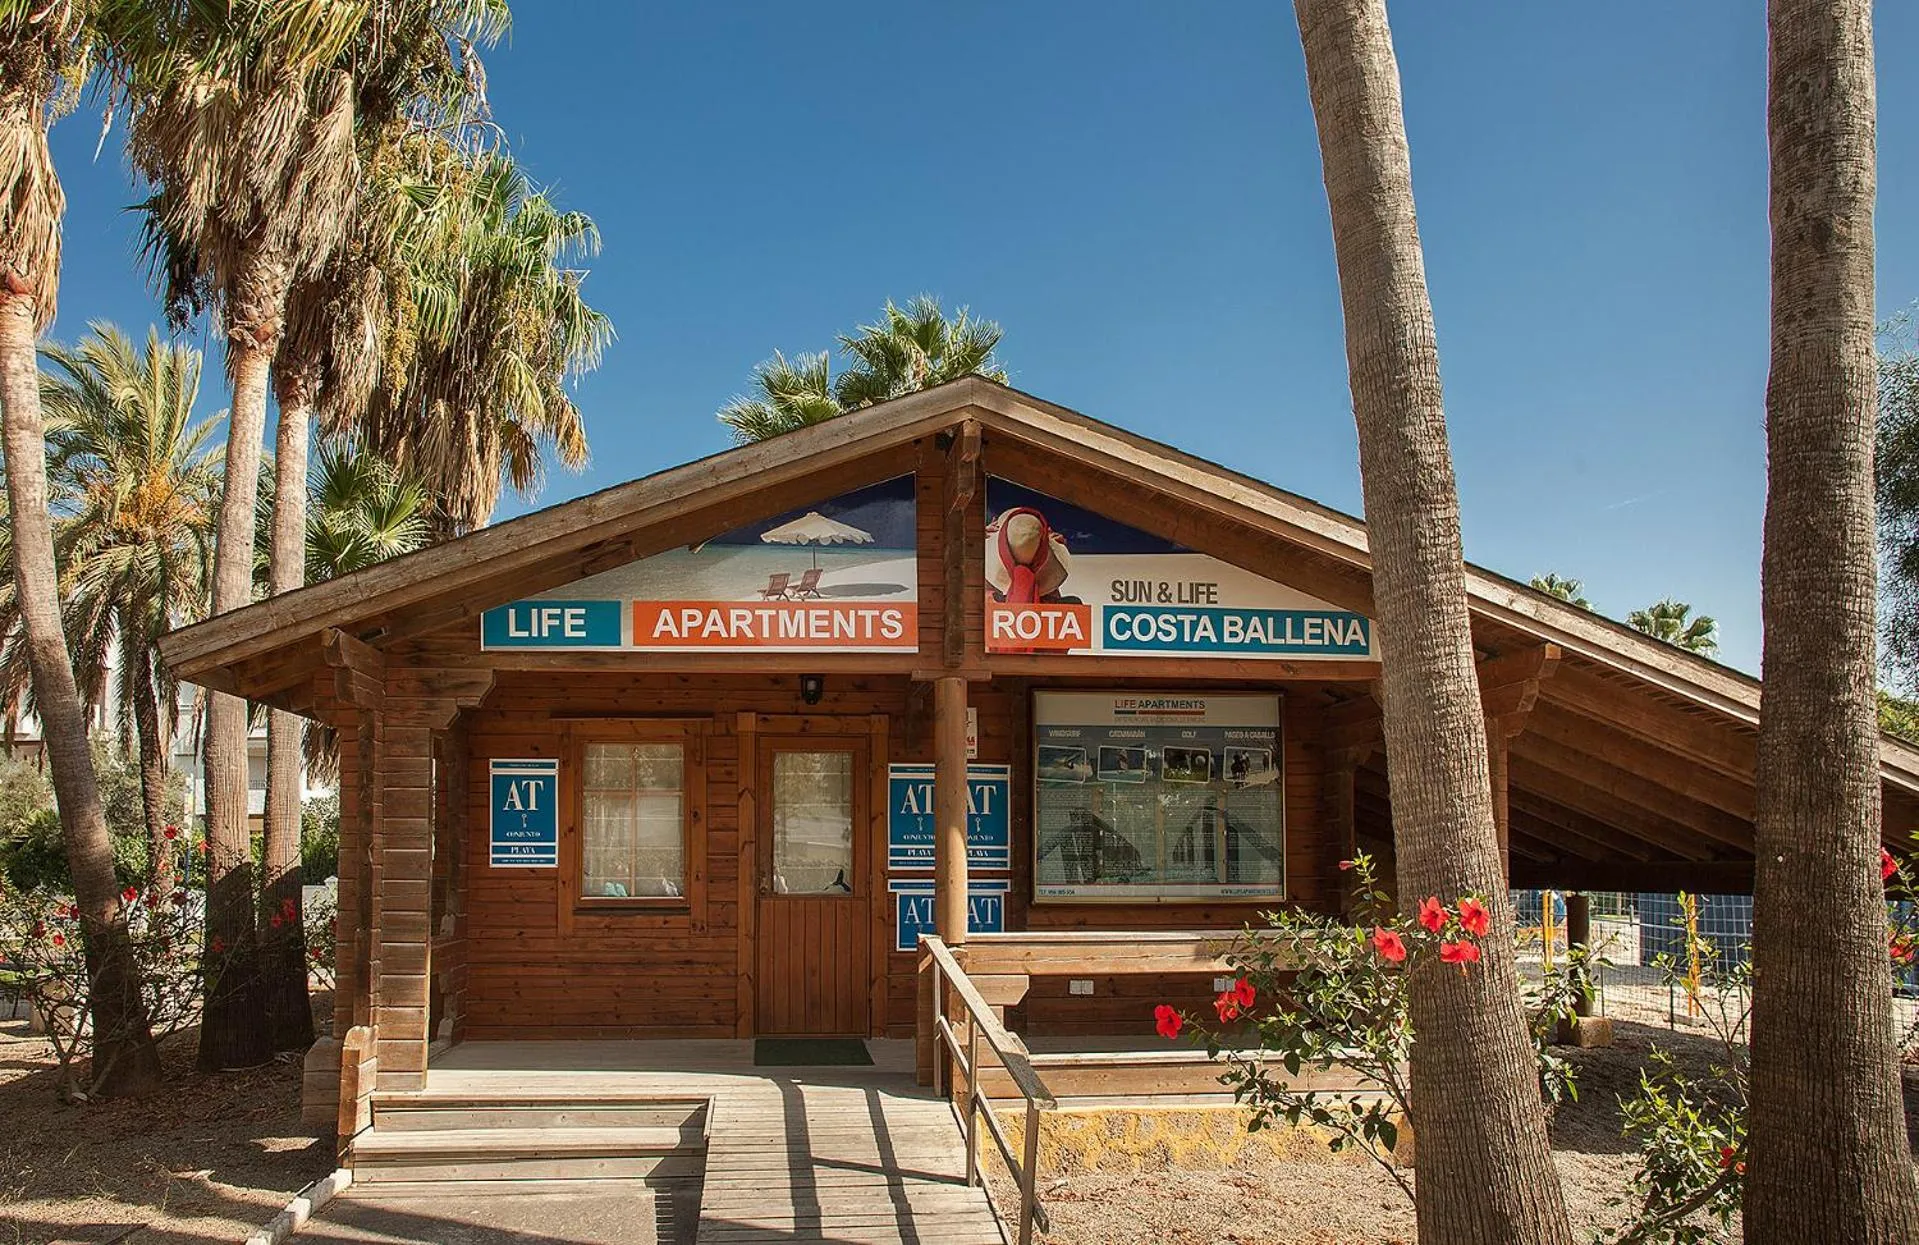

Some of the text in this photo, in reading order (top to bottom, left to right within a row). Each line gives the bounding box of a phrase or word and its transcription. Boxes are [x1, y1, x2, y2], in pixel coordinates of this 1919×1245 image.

[1111, 580, 1218, 605] SUN & LIFE
[508, 608, 904, 639] LIFE APARTMENTS
[992, 610, 1084, 641] ROTA
[1109, 612, 1367, 647] COSTA BALLENA
[1114, 699, 1205, 709] LIFE APARTMENTS
[503, 779, 544, 811] AT
[900, 784, 935, 815] AT
[511, 846, 536, 855] PLAYA
[907, 849, 932, 857] PLAYA
[904, 897, 935, 924] AT
[967, 897, 999, 924] AT
